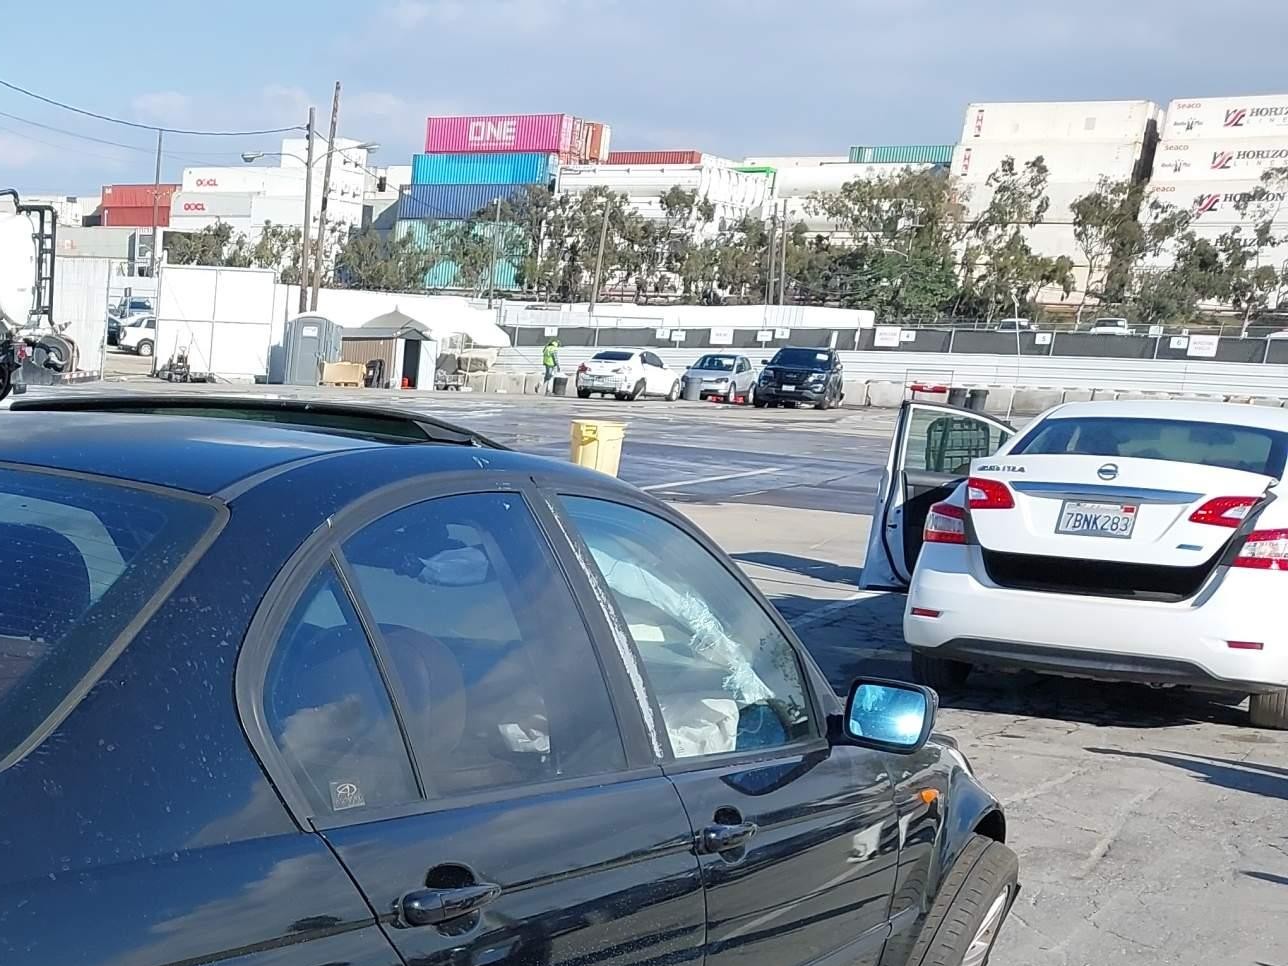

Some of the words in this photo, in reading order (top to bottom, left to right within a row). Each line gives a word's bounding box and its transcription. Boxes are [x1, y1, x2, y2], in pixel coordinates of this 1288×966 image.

[468, 120, 517, 142] ONE
[1223, 192, 1286, 202] HOZON
[183, 202, 206, 211] OOCL
[1065, 512, 1131, 532] 7BNK283
